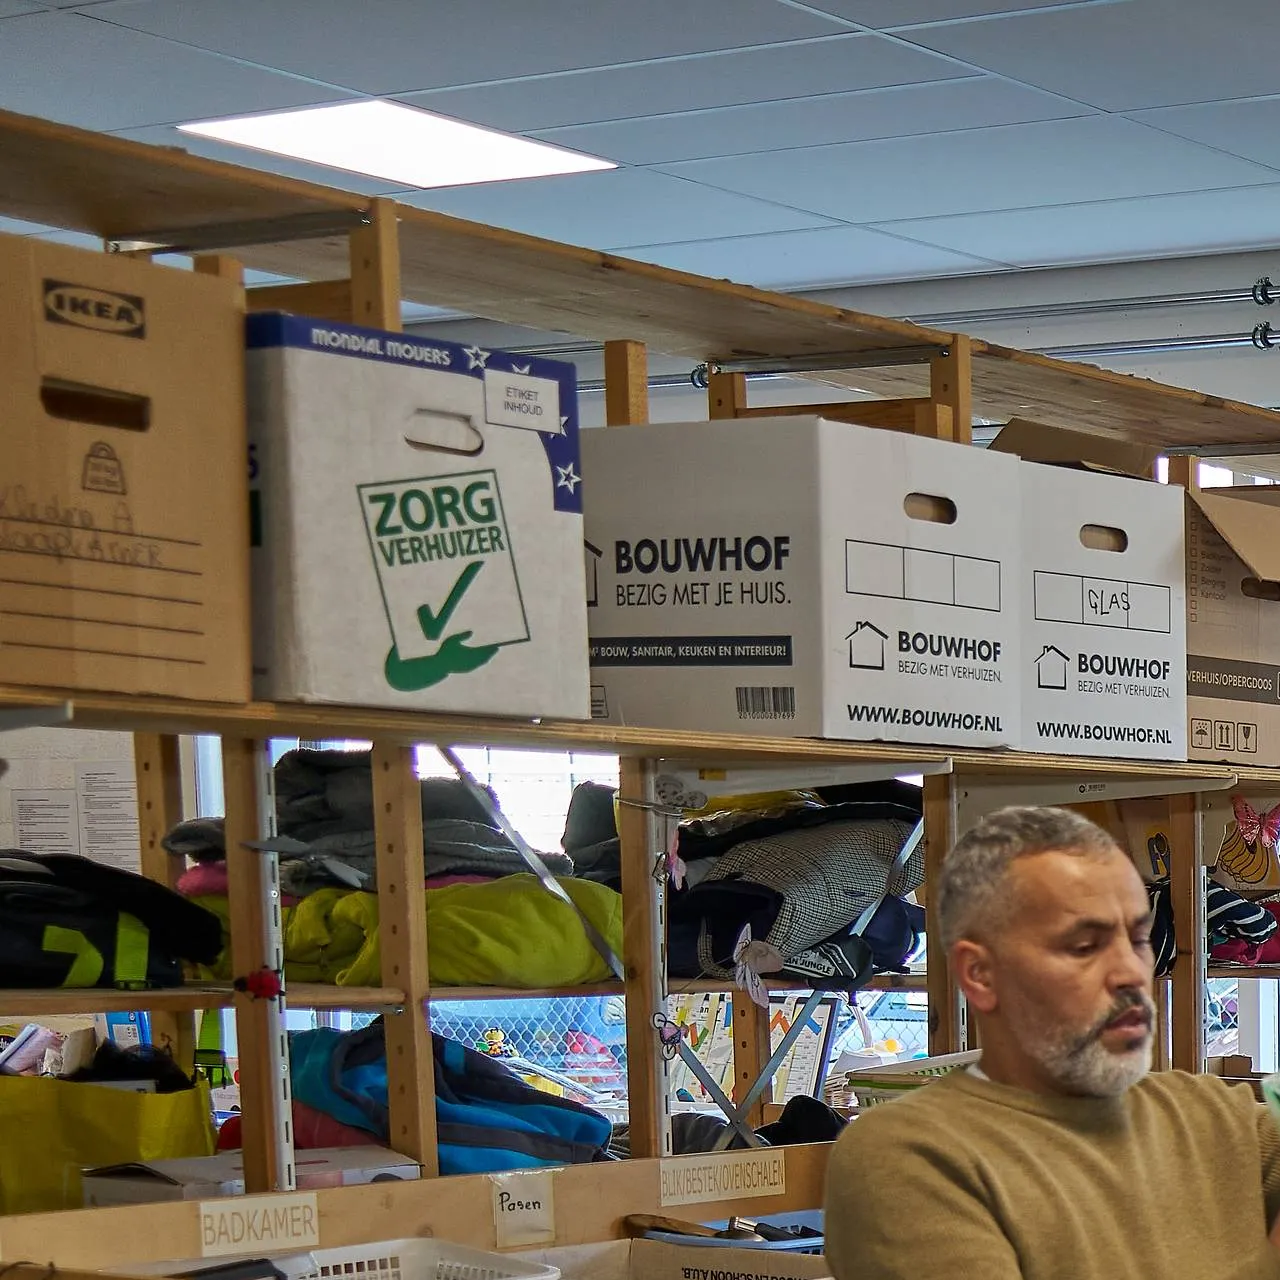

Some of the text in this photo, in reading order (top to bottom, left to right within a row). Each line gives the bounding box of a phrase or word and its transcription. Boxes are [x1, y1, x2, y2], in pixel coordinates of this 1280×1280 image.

[56, 291, 136, 329] IKEA
[506, 387, 538, 401] ETIKET
[504, 401, 543, 416] INHOUD
[369, 481, 498, 537] ZORG
[377, 526, 505, 568] VERHUIZER
[615, 536, 790, 574] BOUWHOF
[616, 582, 791, 607] BEZIG MET JE HUIS.
[1088, 589, 1131, 616] GLAS
[601, 646, 786, 658] BOUW, SANITAIR, KEUKEN EN INTERIEUR!
[898, 631, 1001, 662] BOUWHOF
[898, 660, 928, 675] BEZIG
[930, 663, 948, 677] MET
[1078, 653, 1170, 681] BOUWHOF
[1078, 680, 1103, 694] BEZIG
[1105, 682, 1122, 695] MET
[847, 704, 1002, 732] WWW.BOUWHOF.NL
[1037, 721, 1172, 744] WWW.BOUWHOF.NL
[800, 958, 832, 974] JUNGLE
[661, 1158, 785, 1198] BLIK/BESTEK/OVENSCHALEN
[499, 1191, 541, 1213] Pasen
[203, 1204, 317, 1246] BADKAMER
[681, 1267, 709, 1280] A.U.B.
